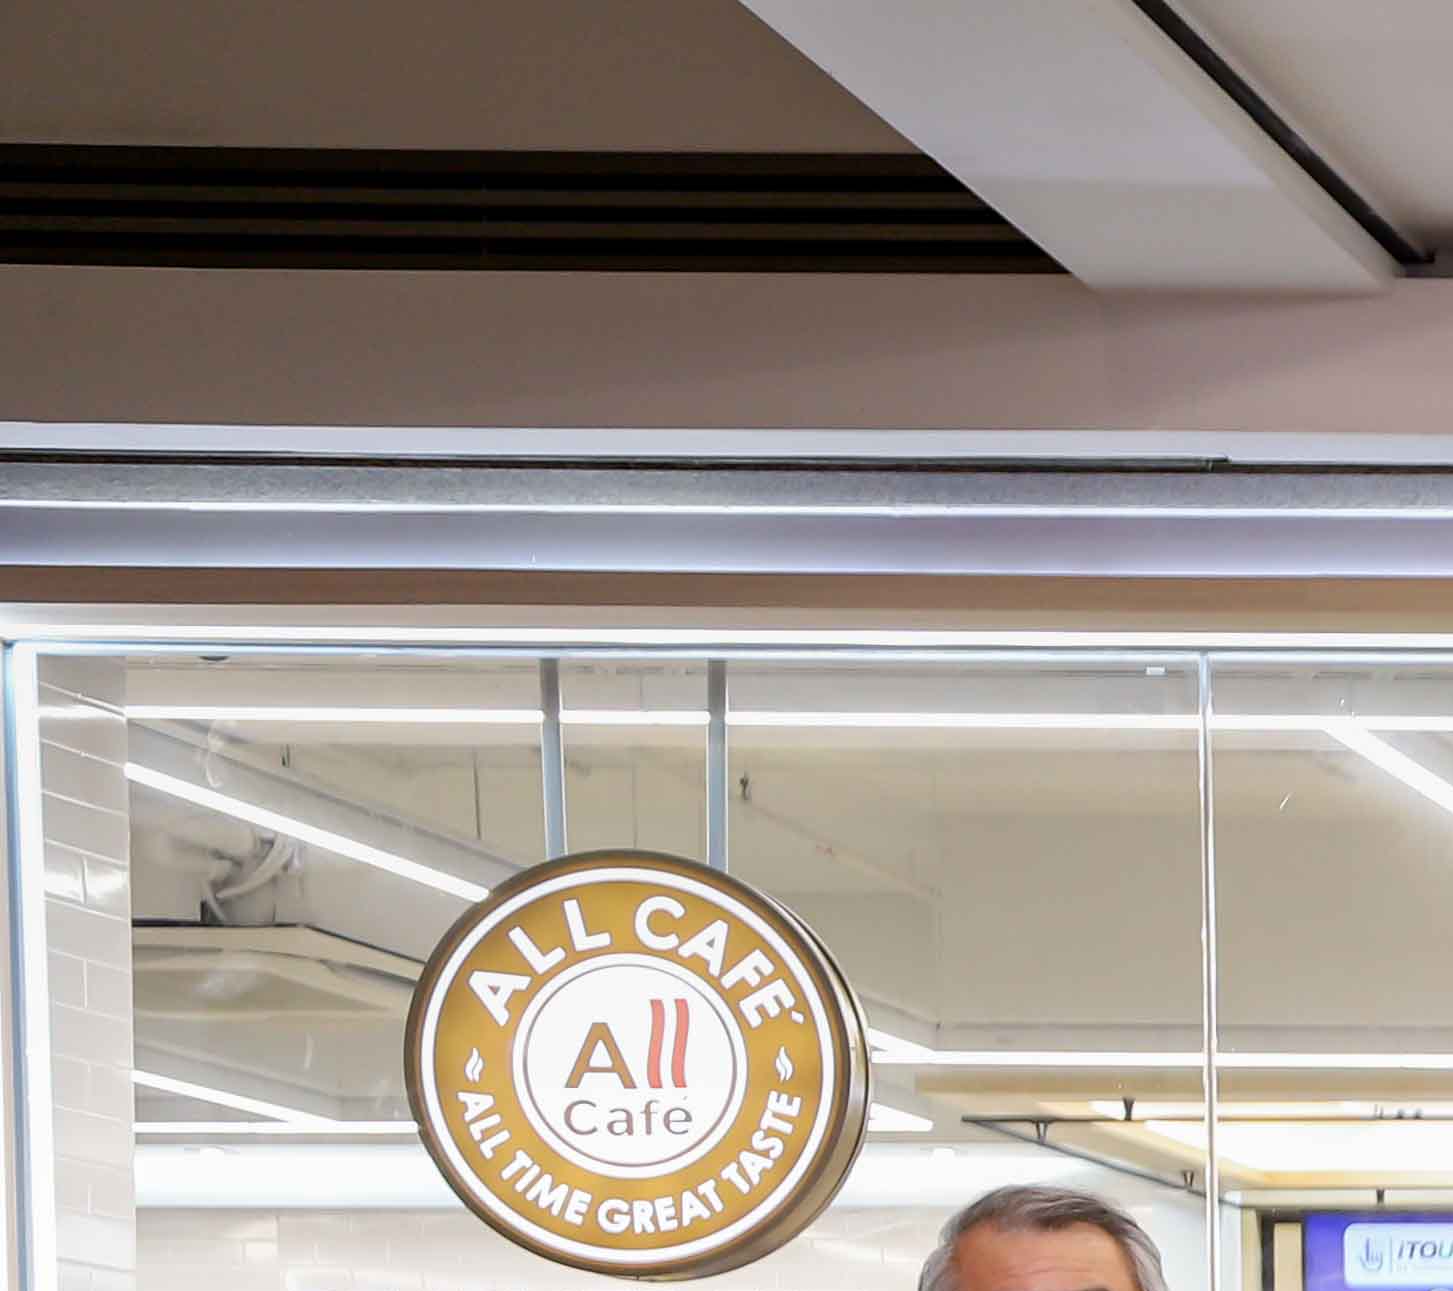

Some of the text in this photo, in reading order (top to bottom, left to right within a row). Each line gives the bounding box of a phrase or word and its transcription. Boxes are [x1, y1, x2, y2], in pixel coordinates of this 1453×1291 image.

[468, 898, 612, 1028] ALL
[457, 1088, 802, 1236] ALL TIME GREAT TASTE
